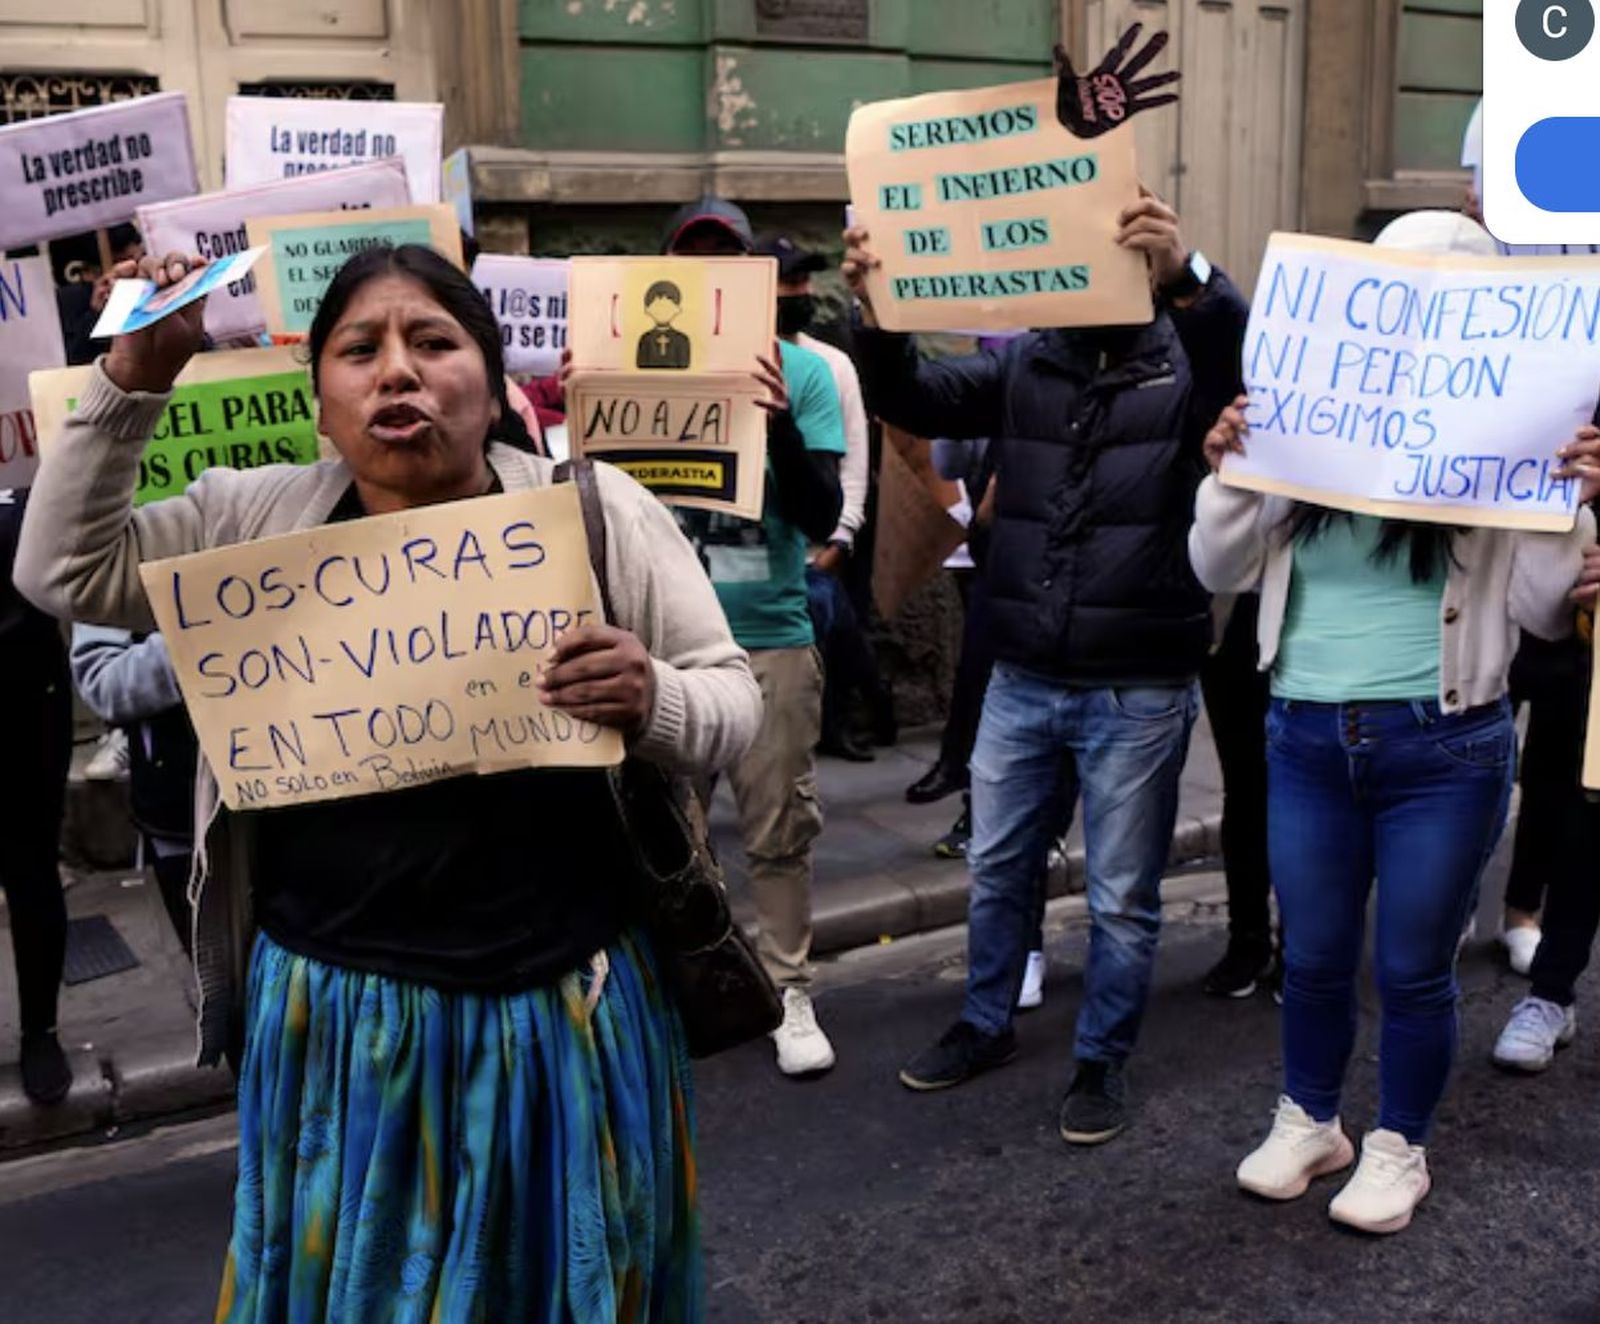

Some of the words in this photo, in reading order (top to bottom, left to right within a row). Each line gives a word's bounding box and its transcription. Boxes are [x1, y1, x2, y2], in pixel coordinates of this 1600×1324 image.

[270, 124, 291, 154] La
[297, 128, 367, 157] verdad
[372, 133, 396, 159] no
[890, 107, 1036, 149] SEREMOS
[21, 153, 46, 184] La
[48, 133, 122, 178] verdad
[126, 132, 152, 161] no
[43, 167, 144, 218] prescribe
[883, 187, 921, 210] EL
[940, 156, 1097, 202] INFIERNO
[195, 221, 250, 261] Cond
[284, 242, 308, 258] NO
[907, 230, 948, 254] DE
[985, 219, 1049, 249] LOS
[894, 265, 1090, 299] PEDERASTAS
[1264, 262, 1326, 323] NI
[520, 325, 545, 349] se
[1250, 331, 1309, 384] NI
[222, 388, 312, 432] PARA
[584, 399, 641, 438] NO
[651, 399, 669, 437] A
[678, 401, 722, 444] LA
[1245, 386, 1437, 451] EXIGIMOS
[229, 720, 306, 772] EN
[313, 699, 455, 757] TODO
[236, 778, 269, 804] NO
